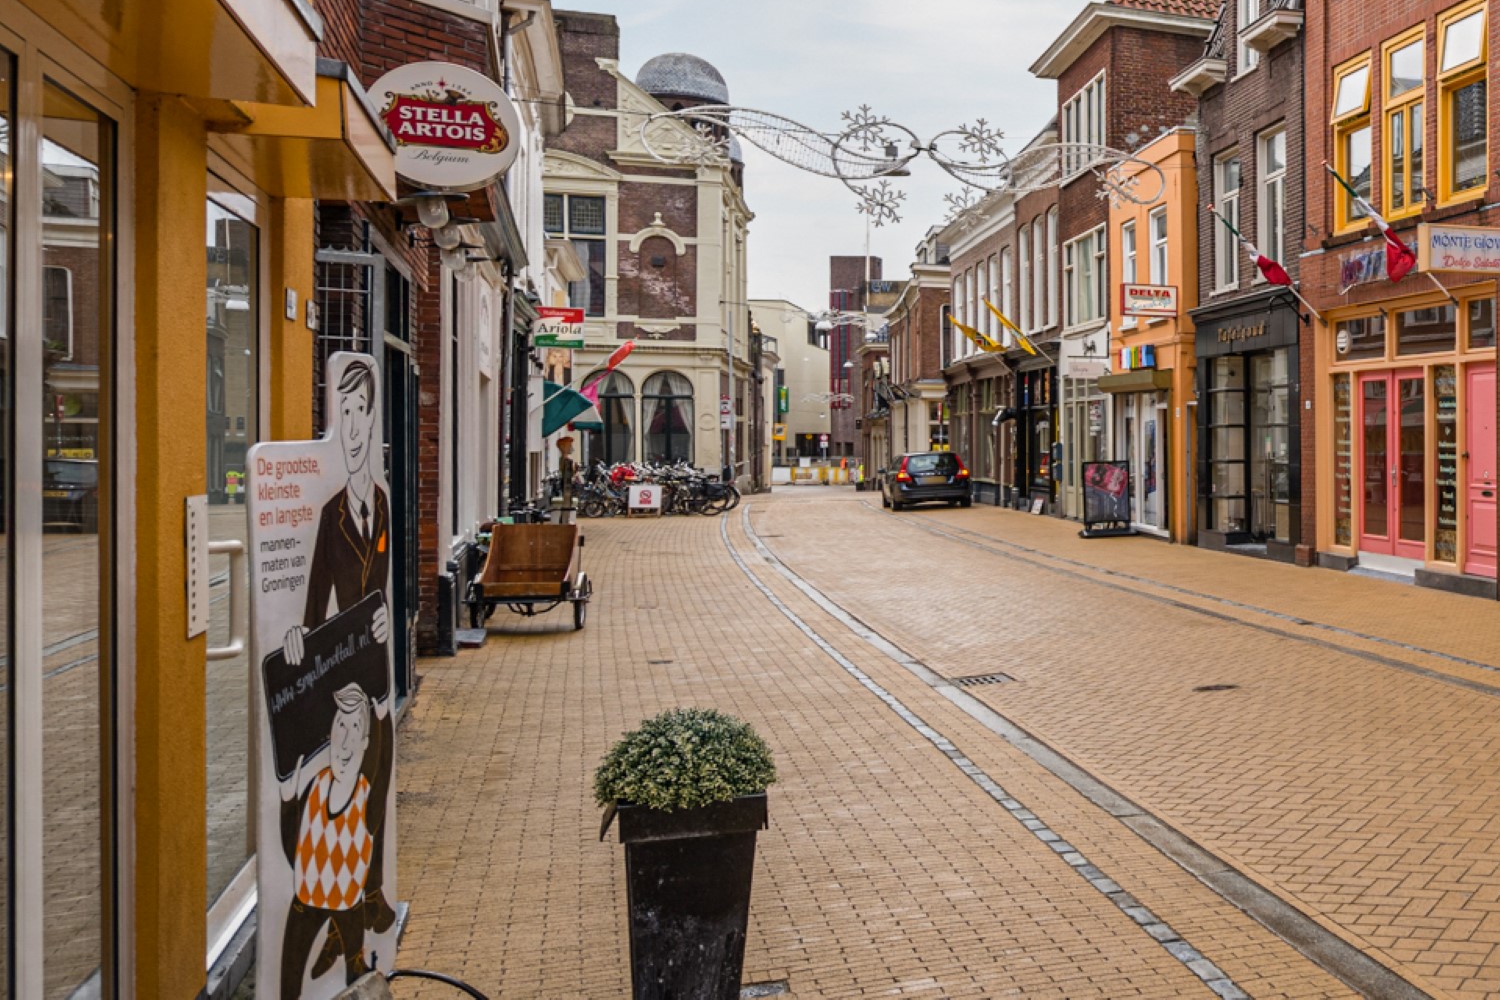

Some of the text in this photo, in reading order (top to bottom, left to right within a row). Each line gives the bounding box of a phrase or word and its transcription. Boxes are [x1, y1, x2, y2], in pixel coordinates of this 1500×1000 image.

[399, 105, 485, 126] STELLA
[398, 121, 486, 141] ARTOIS
[408, 149, 470, 165] Belgium
[1129, 288, 1171, 298] DELTA
[537, 321, 582, 335] Ariola
[256, 458, 320, 481] De grootste,
[258, 482, 300, 501] kleinste
[259, 505, 313, 527] en langste
[261, 554, 306, 573] maten van
[261, 574, 305, 593] Groningen
